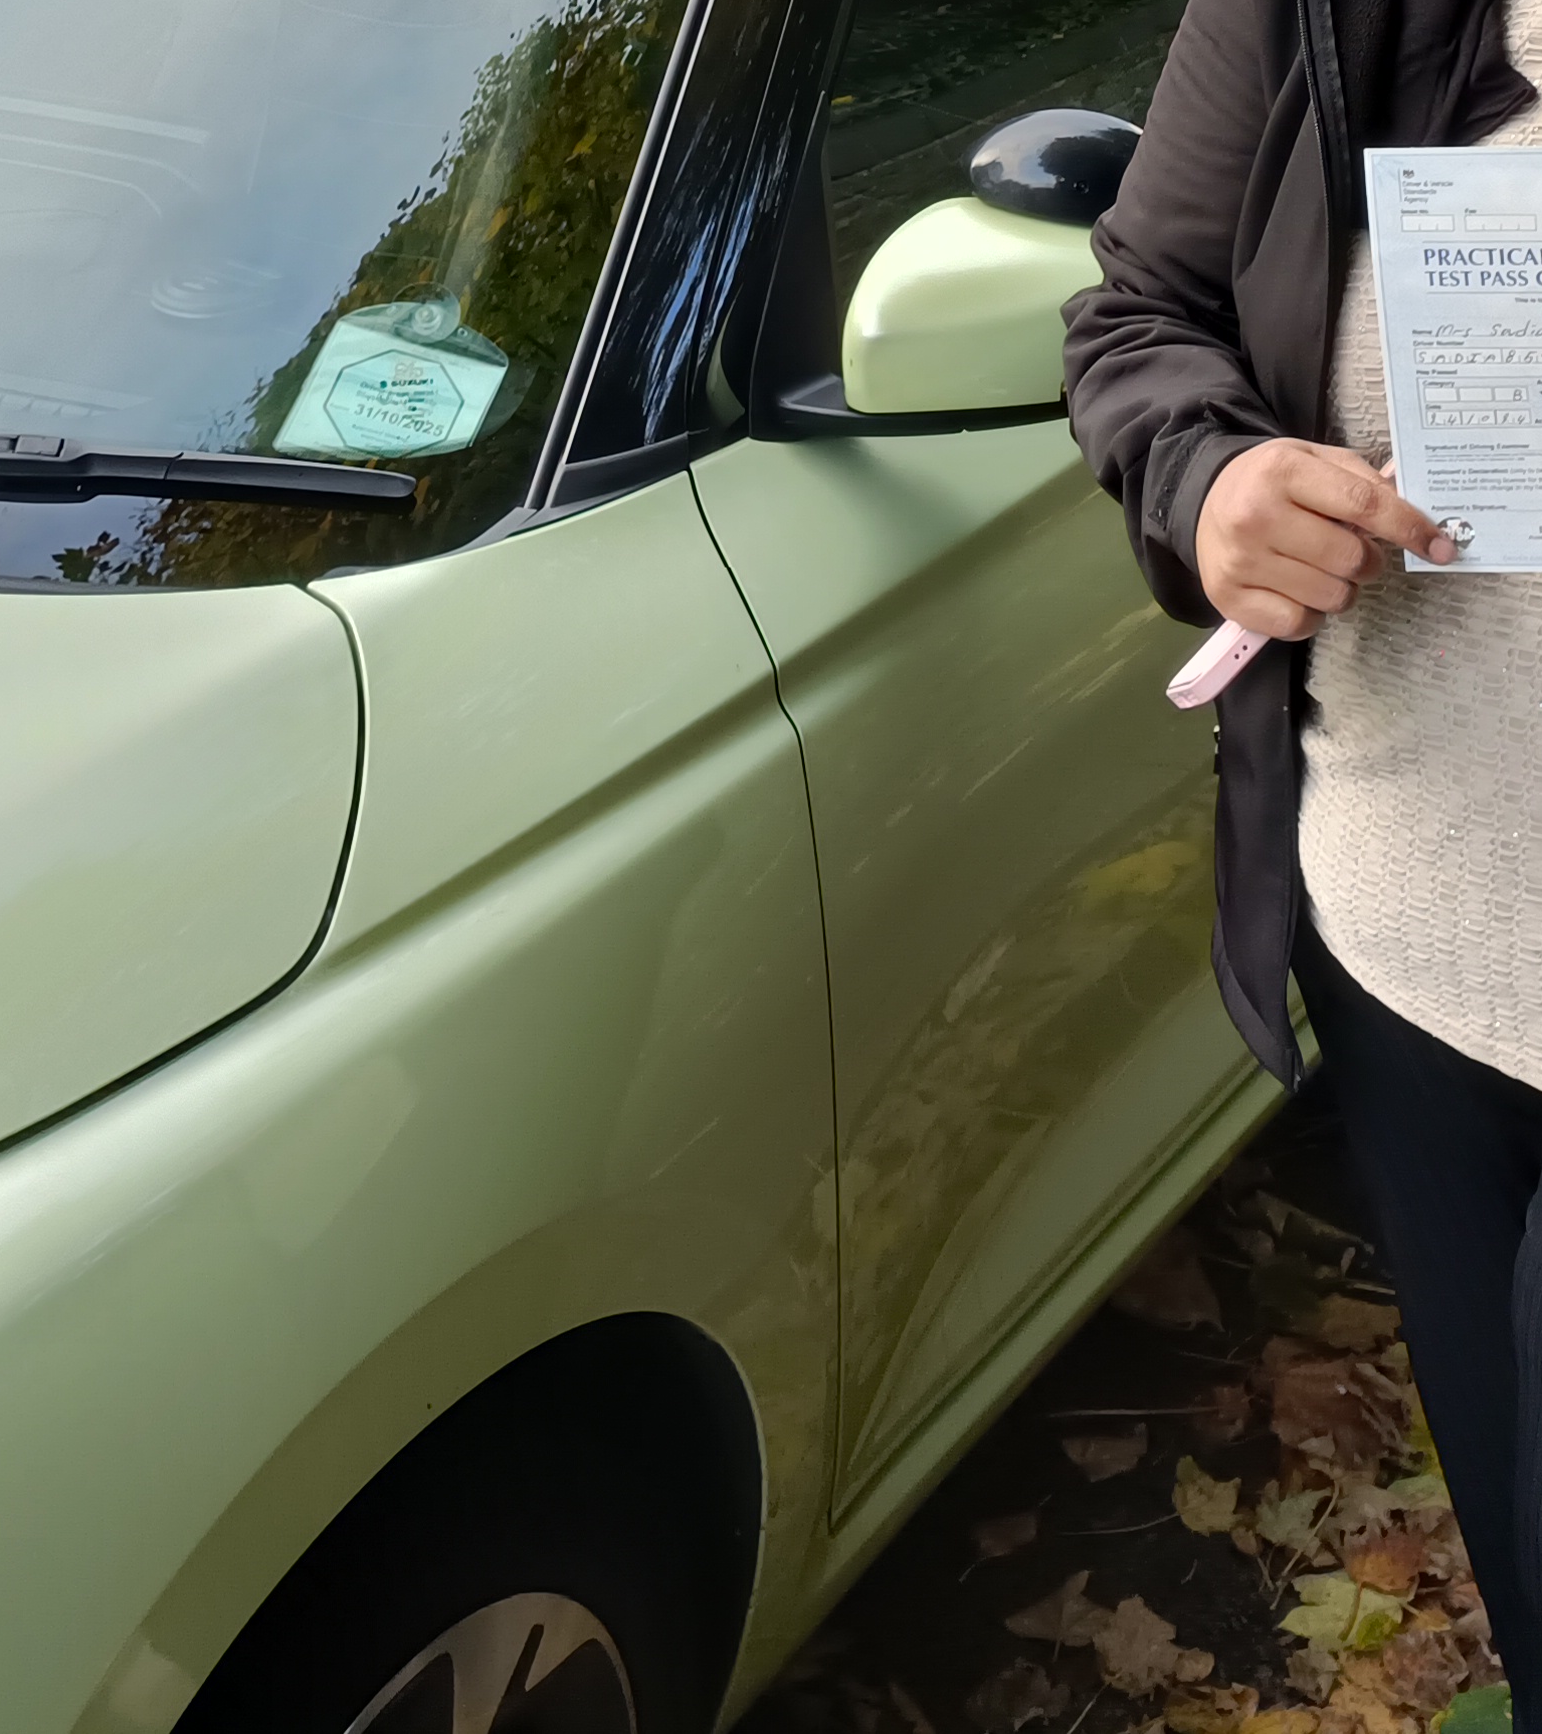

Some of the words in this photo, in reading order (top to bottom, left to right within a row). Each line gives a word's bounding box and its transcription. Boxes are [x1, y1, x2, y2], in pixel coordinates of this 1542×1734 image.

[1424, 270, 1473, 287] TEST
[1480, 270, 1529, 286] PASS
[354, 403, 445, 438] 31/10/2025
